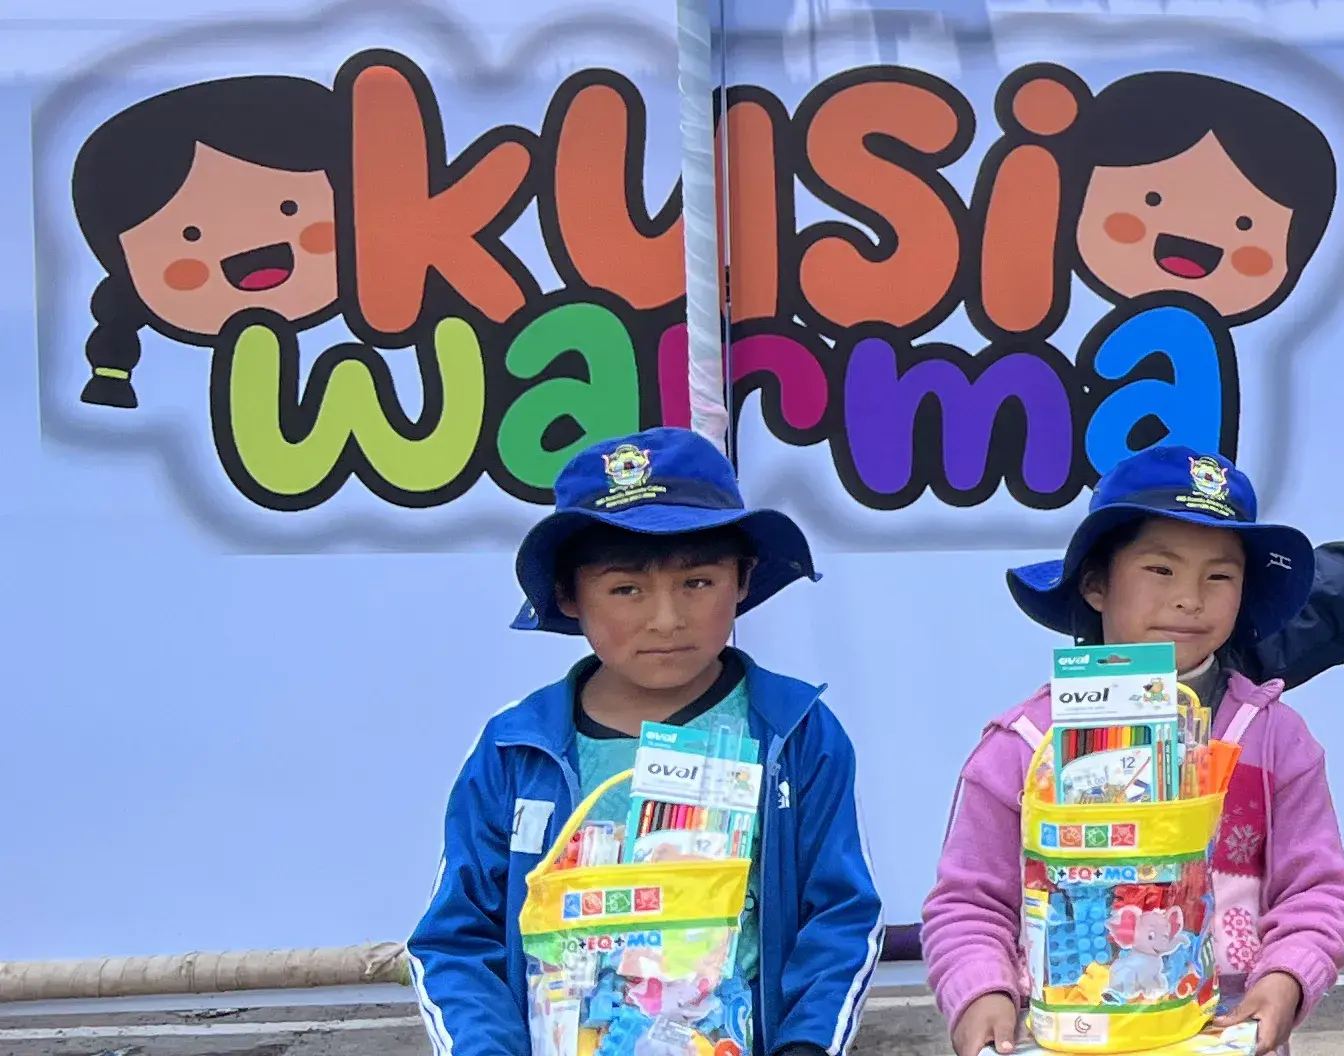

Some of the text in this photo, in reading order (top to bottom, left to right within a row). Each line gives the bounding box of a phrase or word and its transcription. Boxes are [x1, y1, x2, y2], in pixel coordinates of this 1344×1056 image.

[334, 48, 1094, 348] kusi
[211, 290, 1238, 511] warma
[1058, 655, 1090, 666] oval
[1059, 688, 1110, 703] oval
[1120, 756, 1136, 768] 12
[647, 763, 698, 780] oval
[1046, 865, 1137, 884] Q+EQ+MQ
